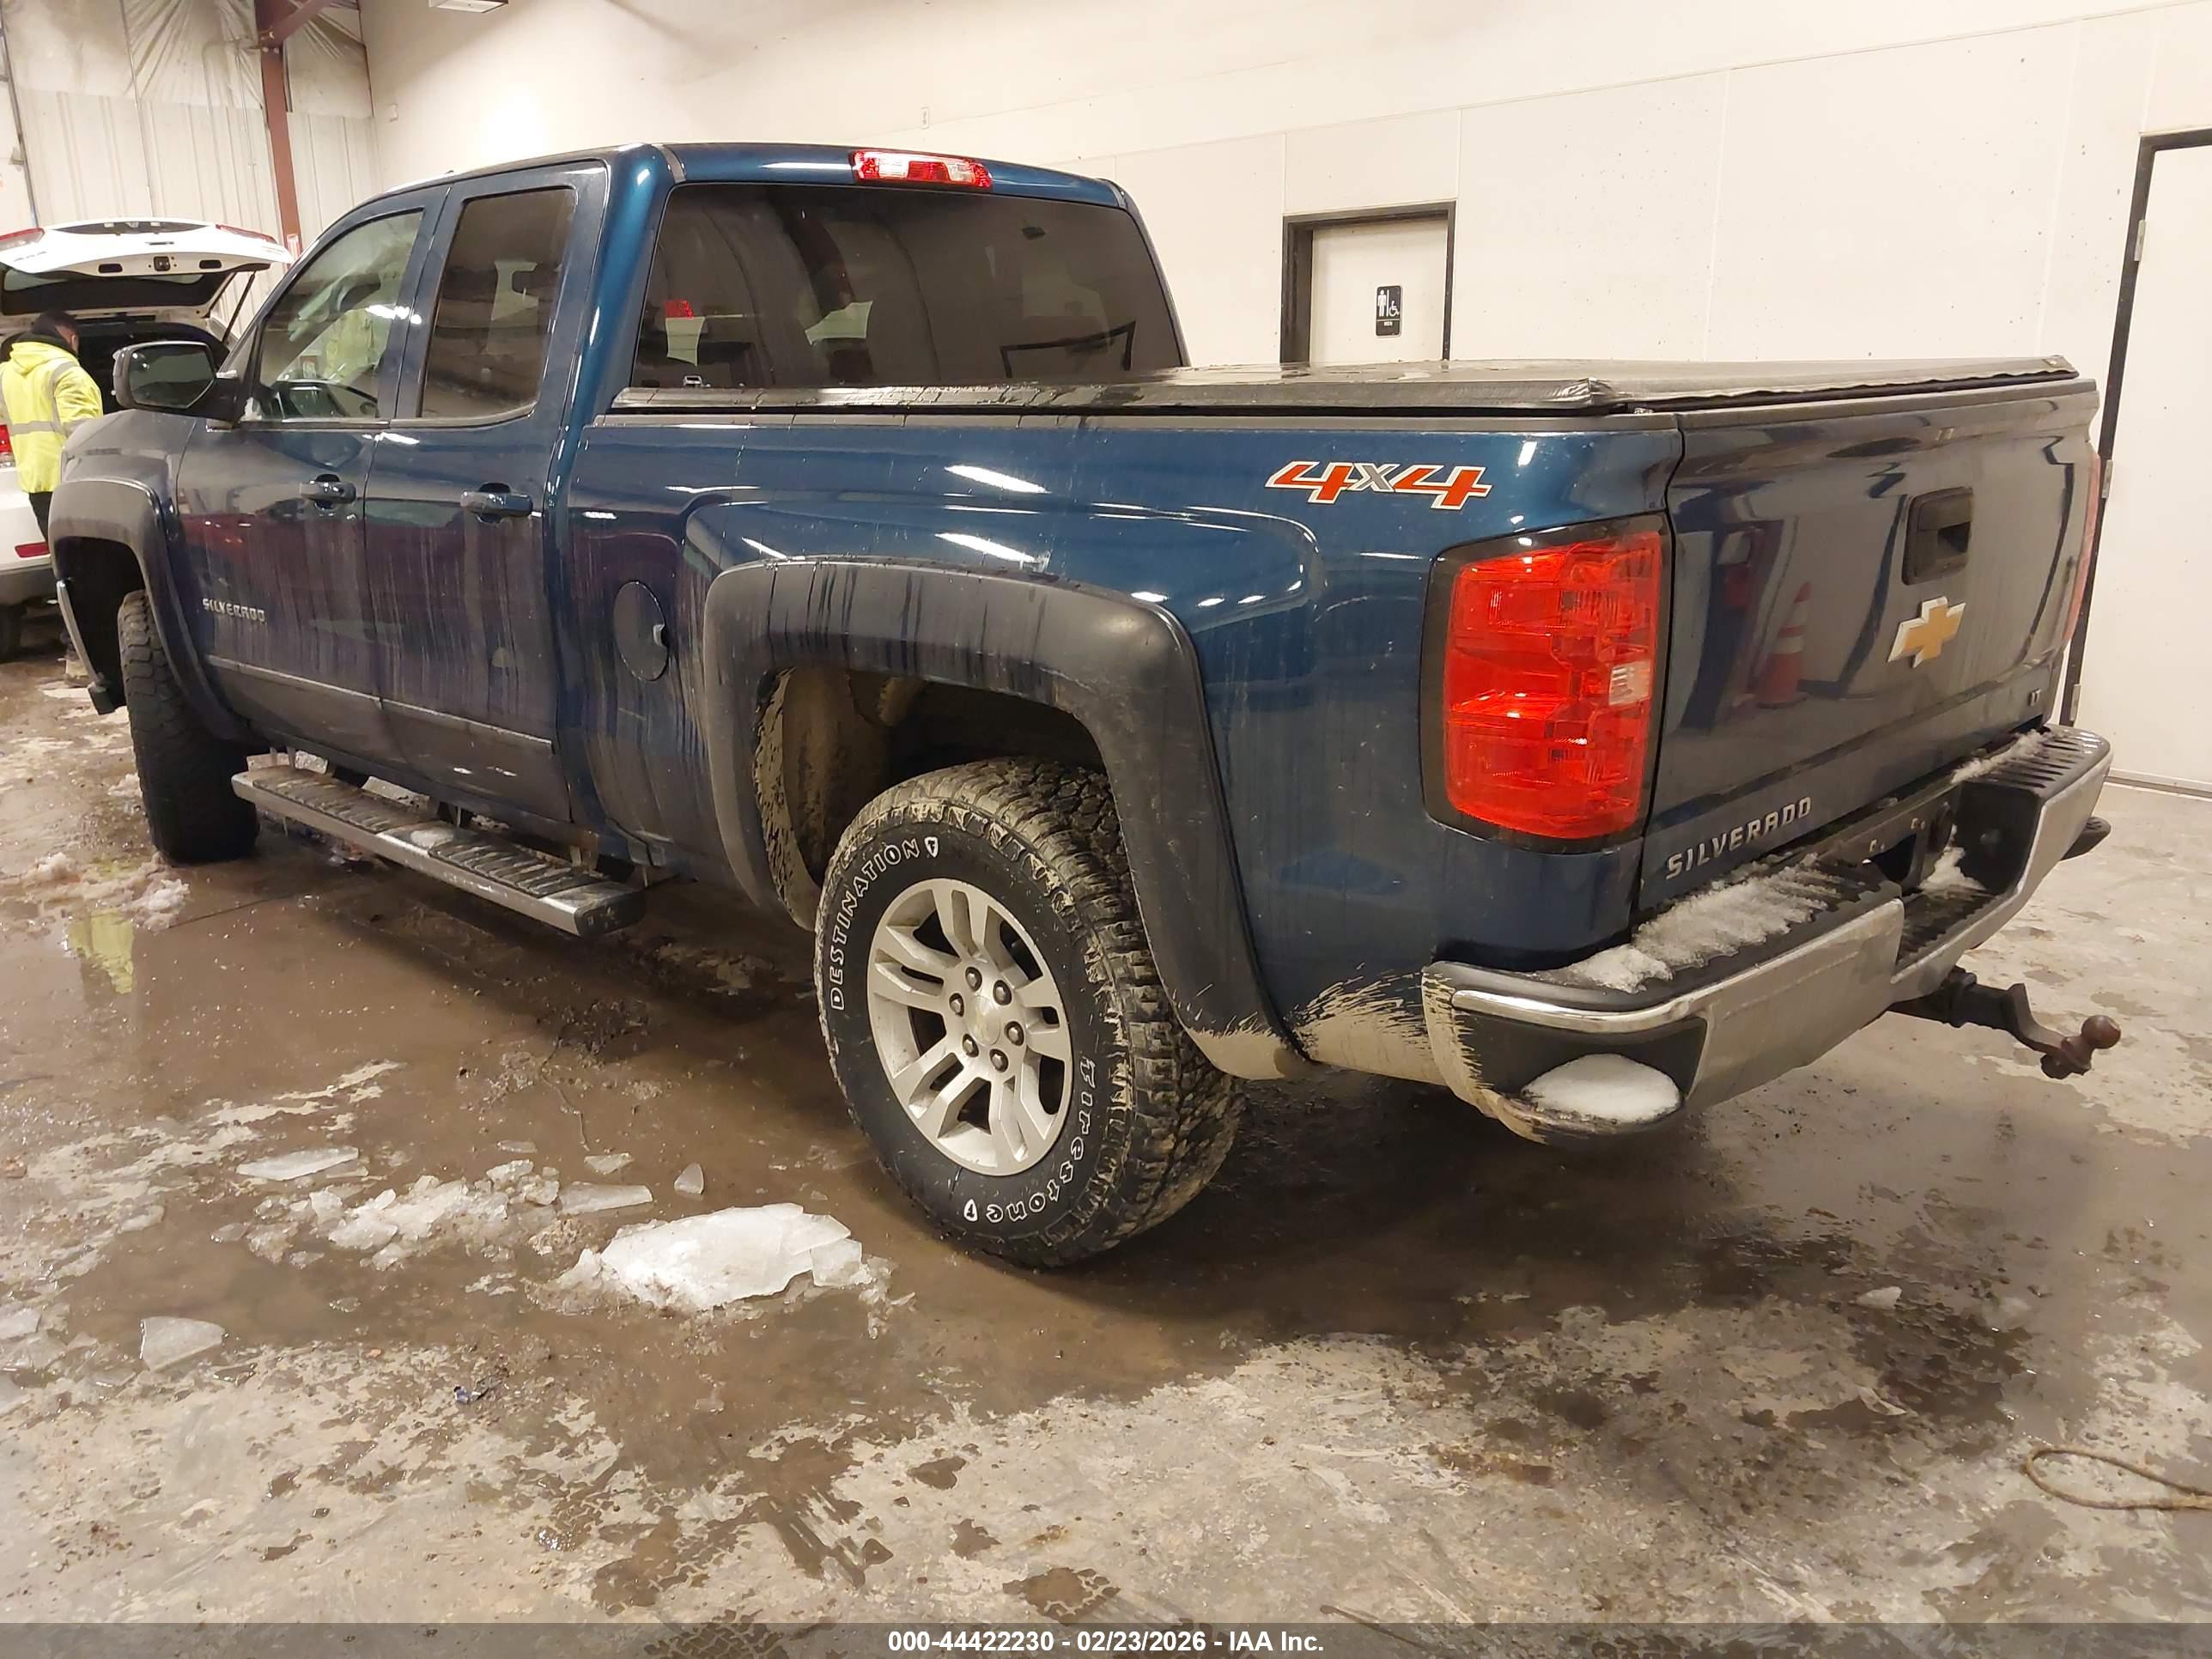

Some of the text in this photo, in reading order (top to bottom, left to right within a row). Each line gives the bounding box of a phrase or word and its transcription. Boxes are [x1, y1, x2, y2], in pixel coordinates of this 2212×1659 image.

[202, 598, 265, 622] SILVERADO
[1666, 796, 1812, 880] SILVERADO
[830, 837, 921, 1012] DESTINATION
